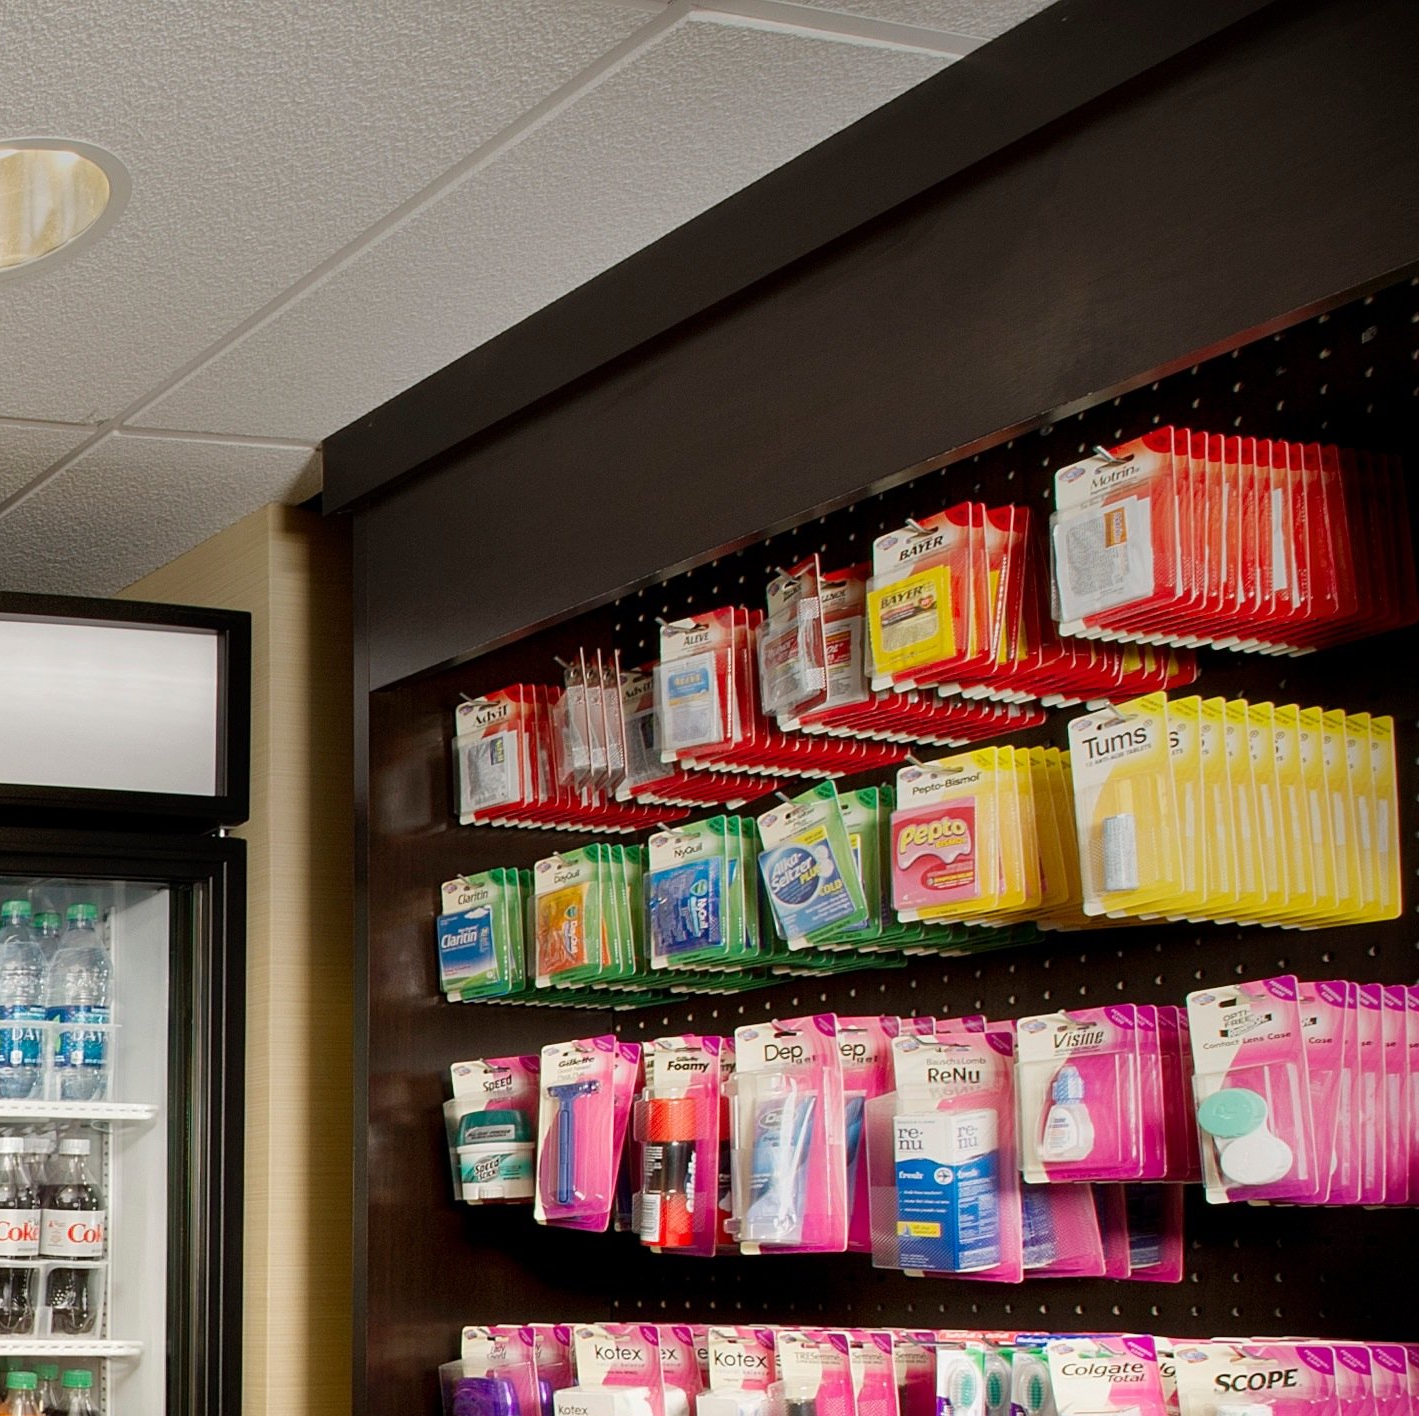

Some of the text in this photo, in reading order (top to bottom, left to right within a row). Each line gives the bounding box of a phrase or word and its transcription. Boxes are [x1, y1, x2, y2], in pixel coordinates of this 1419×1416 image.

[1089, 464, 1137, 491] Motrin
[897, 535, 944, 562] BAYER
[880, 585, 925, 610] BAYER
[1082, 725, 1149, 763] Tums
[911, 772, 983, 797] Pepto-Bismol
[898, 815, 968, 853] Pepto
[457, 888, 489, 906] Claritin
[440, 928, 478, 950] Claritin
[1052, 1028, 1104, 1049] Visine
[1241, 1035, 1265, 1046] Lens
[1267, 1031, 1293, 1042] Case
[764, 1043, 804, 1067] Dep
[666, 1060, 710, 1074] Foamy
[927, 1065, 981, 1086] ReNu
[1061, 1360, 1144, 1379] Colgate
[1107, 1372, 1147, 1384] Total
[1214, 1368, 1299, 1394] SCOPE
